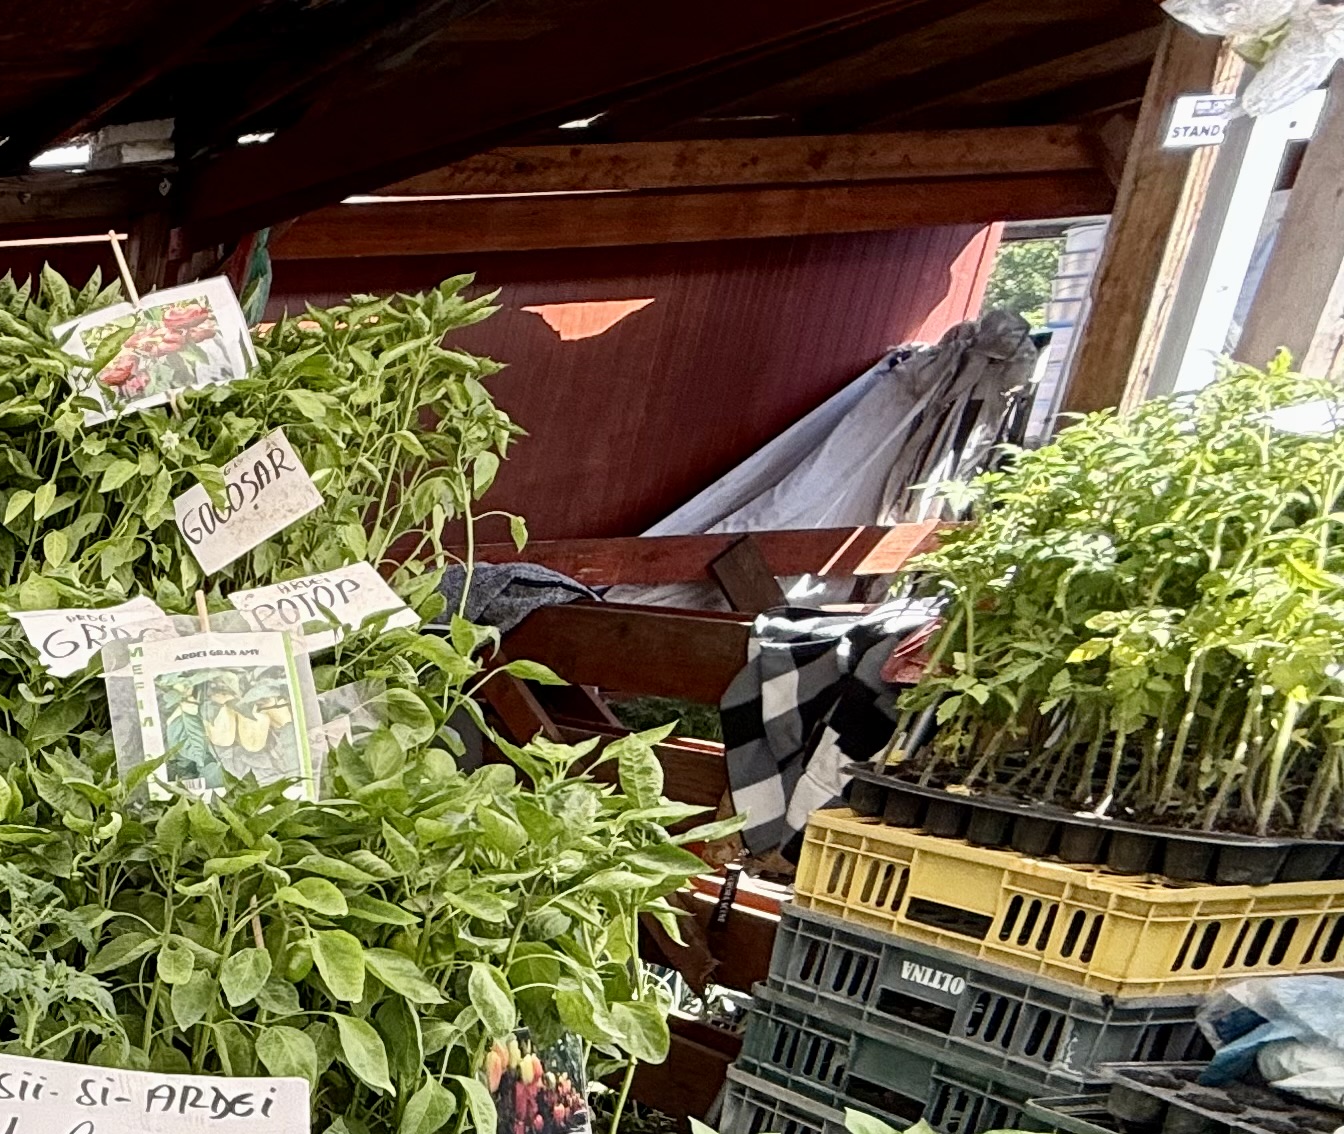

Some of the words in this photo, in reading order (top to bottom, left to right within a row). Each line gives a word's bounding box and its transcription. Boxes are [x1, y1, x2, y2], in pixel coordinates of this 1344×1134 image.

[250, 578, 361, 632] POTOP
[173, 650, 208, 662] ARDEI
[901, 960, 966, 996] OLTINA
